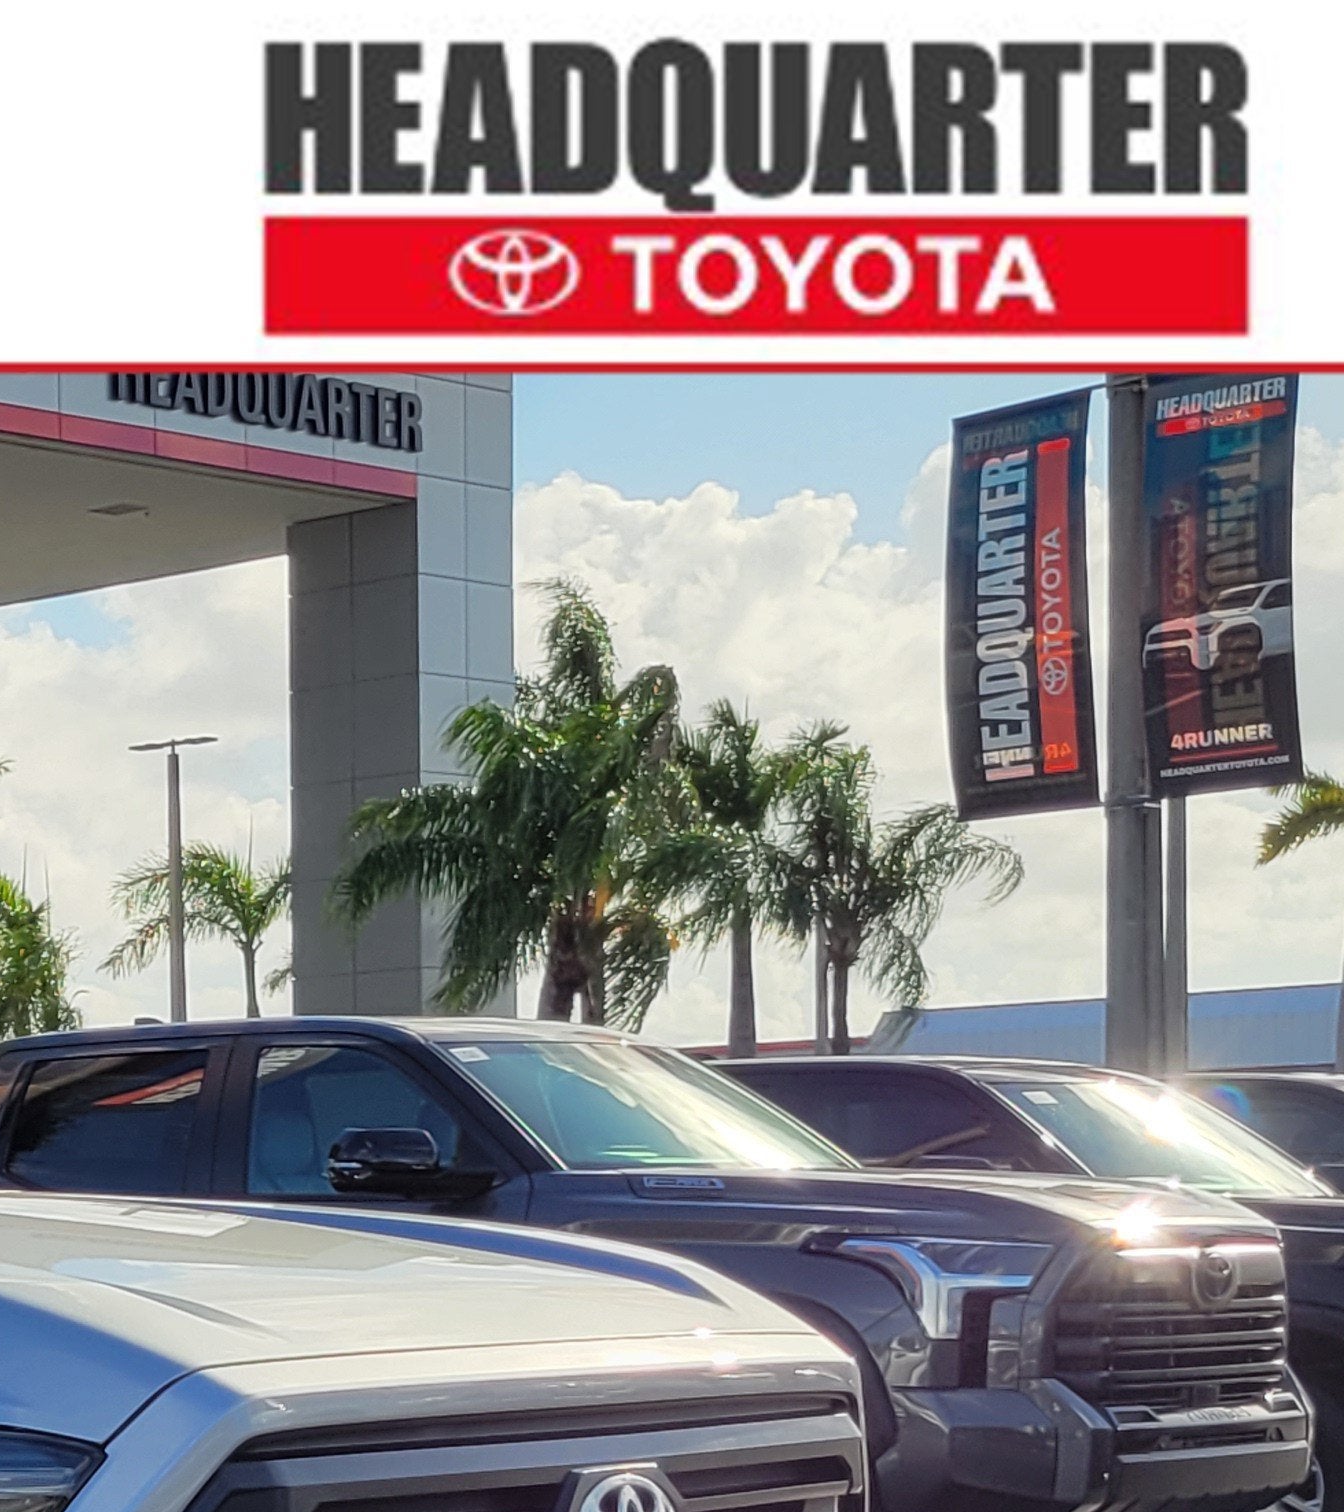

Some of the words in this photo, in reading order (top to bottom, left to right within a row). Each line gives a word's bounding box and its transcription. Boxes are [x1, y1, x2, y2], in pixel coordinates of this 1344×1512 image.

[108, 373, 423, 452] HEADQUARTER
[1156, 376, 1286, 421] HEADQUARTER
[976, 449, 1034, 781] HEADQUARTER
[1040, 527, 1063, 655] TOYOTA
[1160, 755, 1290, 778] HEADQUARTERTOYOTA.COM
[1170, 723, 1273, 751] 4RUNNER
